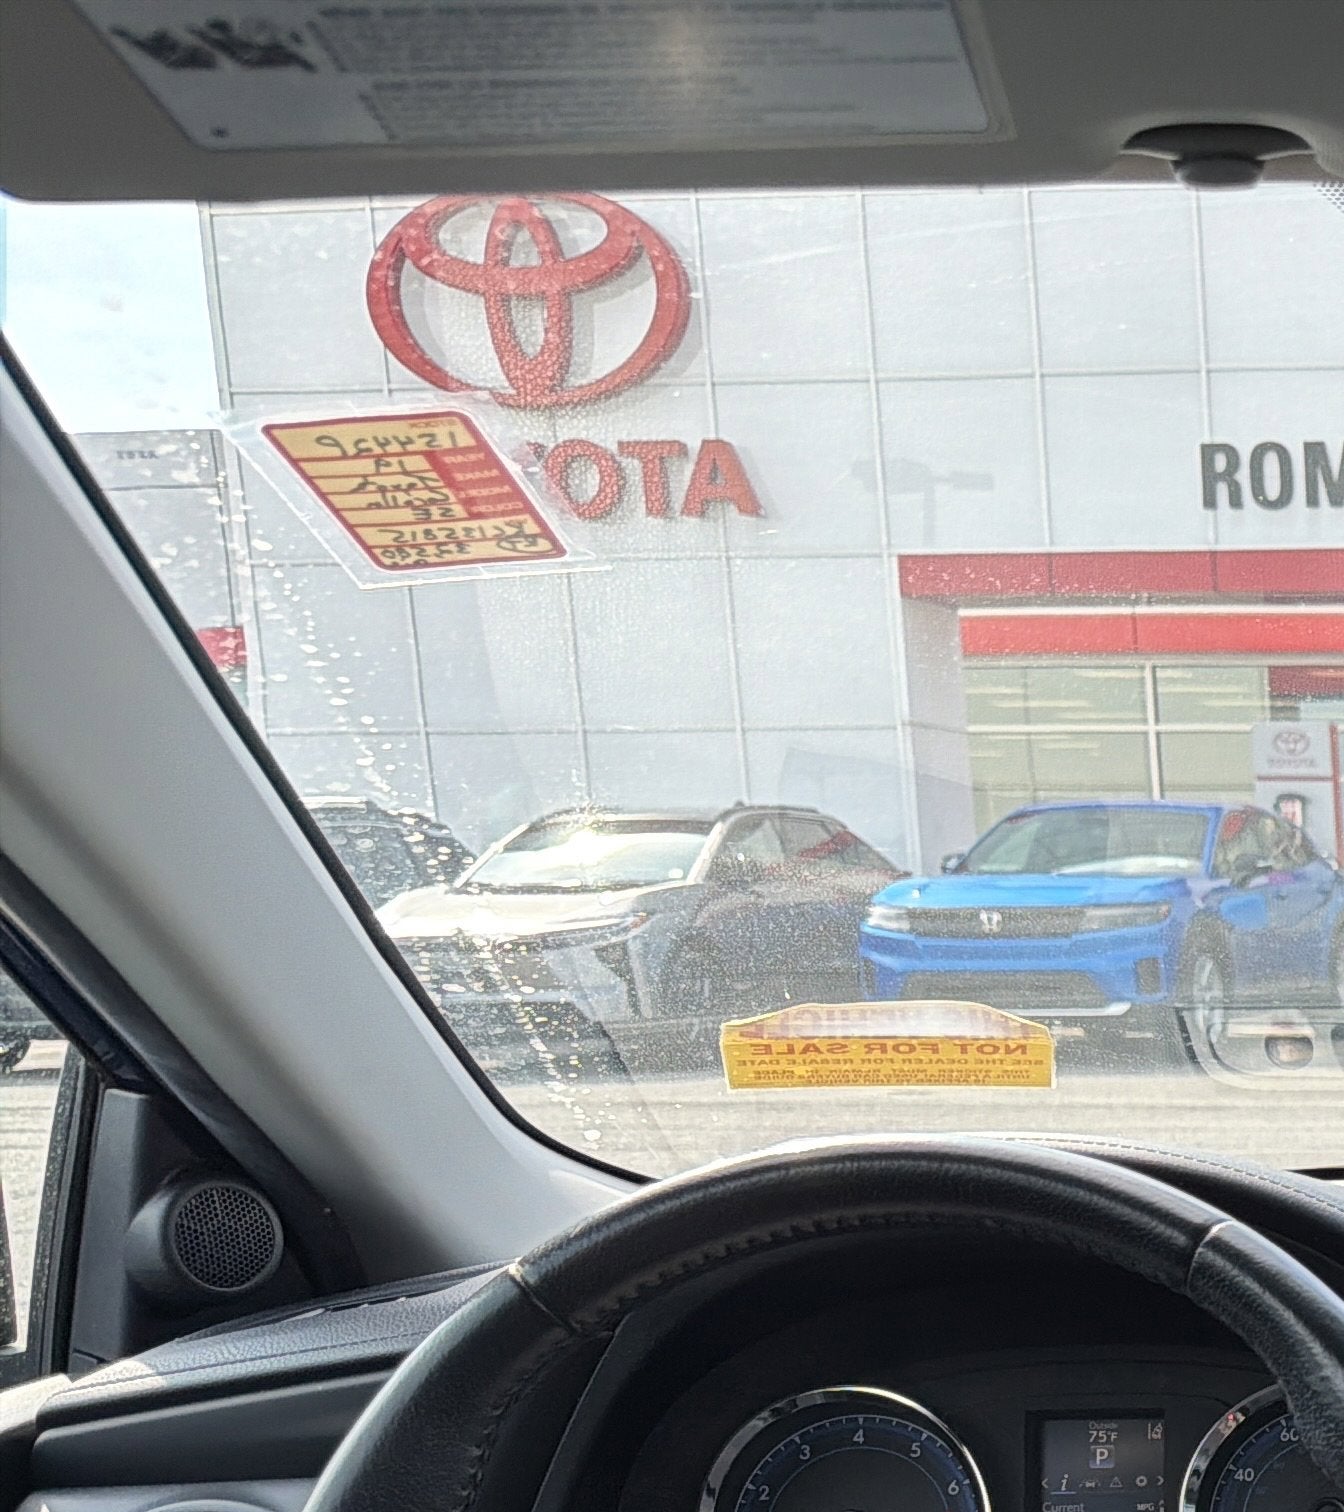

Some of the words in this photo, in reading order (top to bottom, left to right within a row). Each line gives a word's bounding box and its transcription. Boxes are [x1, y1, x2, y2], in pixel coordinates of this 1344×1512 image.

[852, 1429, 865, 1445] 4
[799, 1444, 811, 1461] 3
[910, 1442, 921, 1458] 5
[1096, 1448, 1109, 1465] P
[1234, 1468, 1255, 1482] 40
[758, 1485, 771, 1501] 2
[948, 1479, 960, 1495] 6
[1042, 1502, 1085, 1512] Current
[1136, 1502, 1155, 1511] MPG
